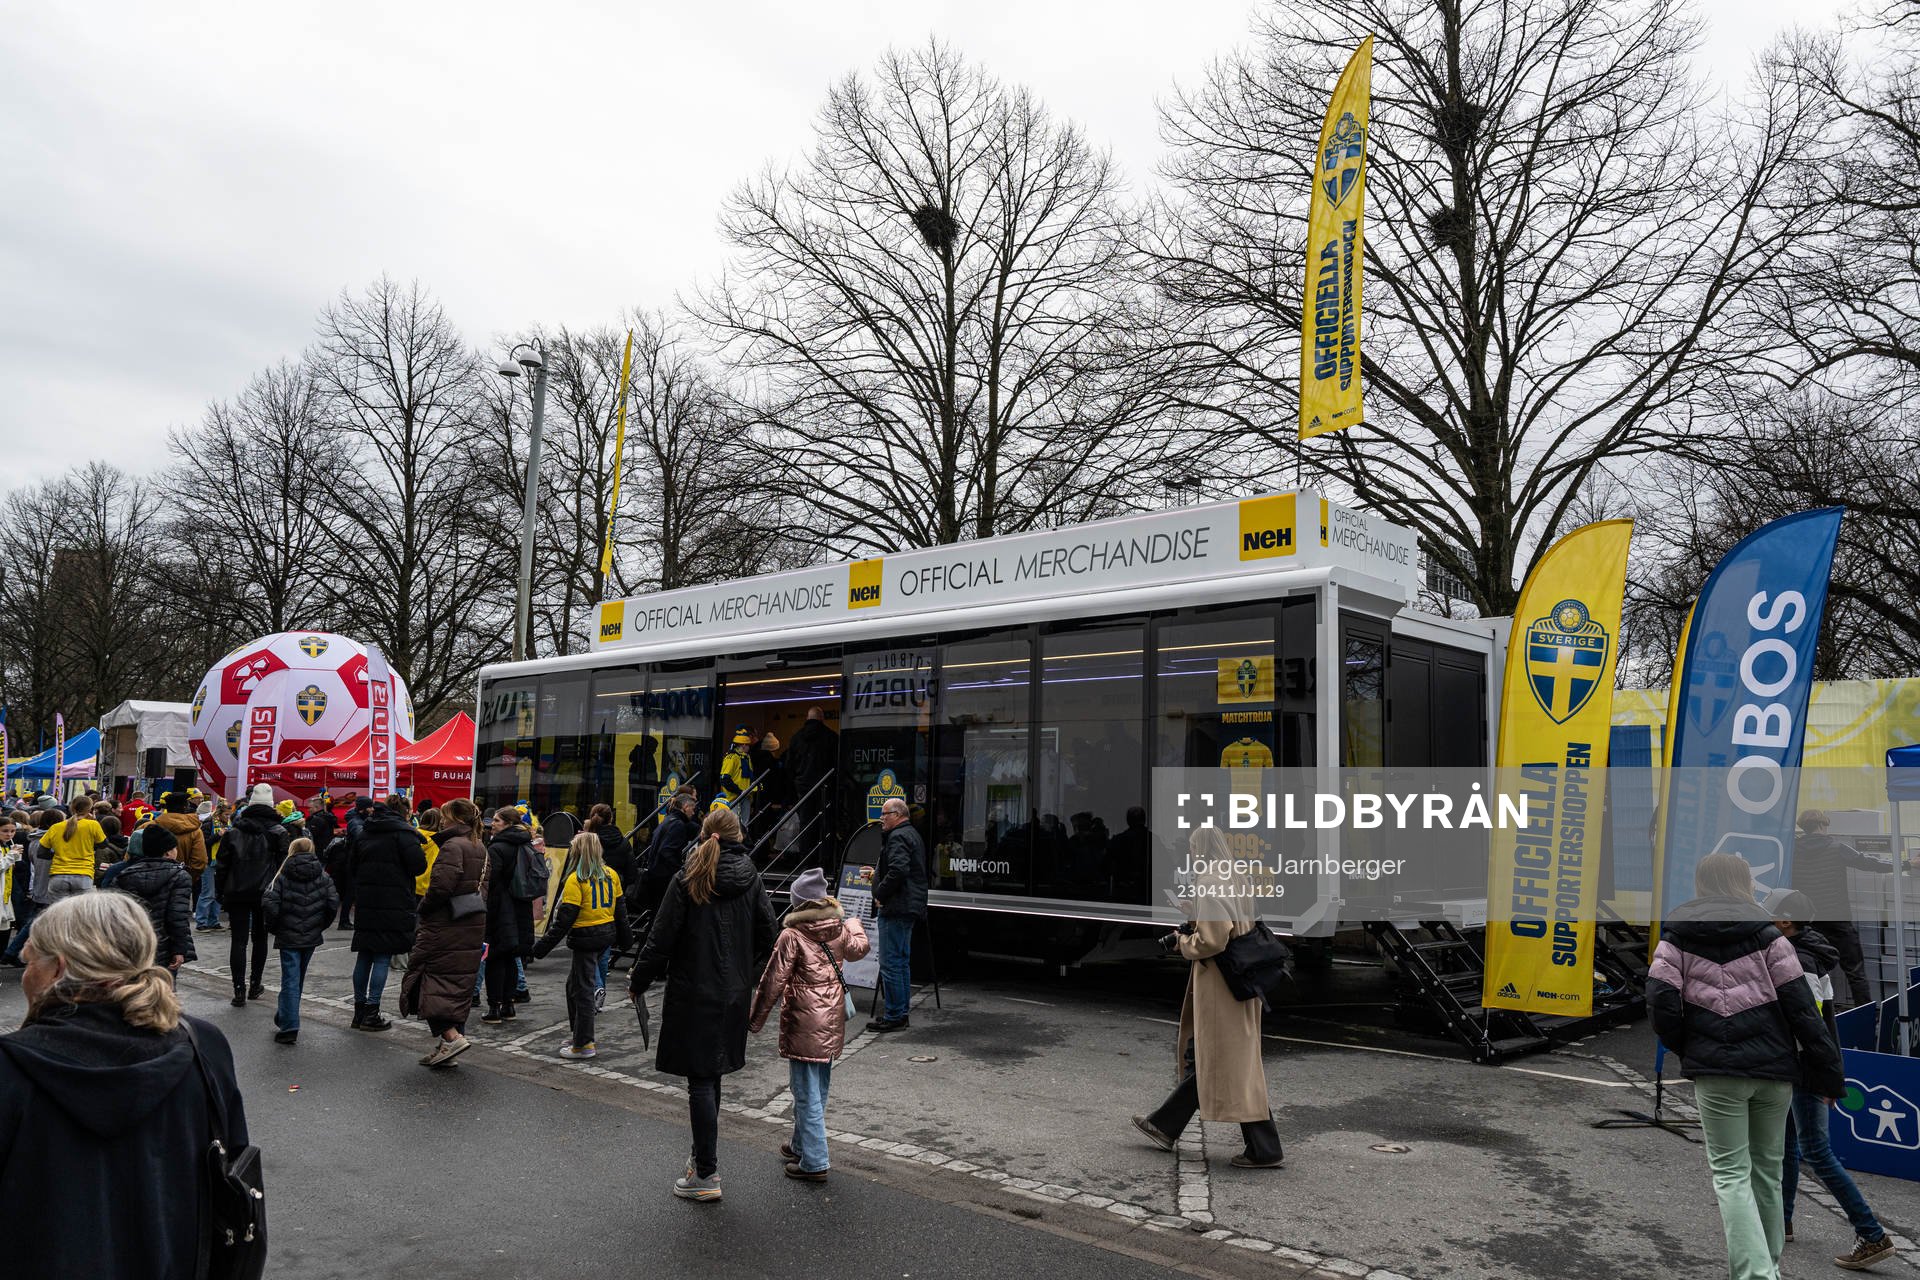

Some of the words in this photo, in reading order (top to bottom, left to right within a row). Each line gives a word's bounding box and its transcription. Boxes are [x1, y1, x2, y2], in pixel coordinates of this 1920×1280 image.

[1314, 239, 1339, 380] OFFICIELLA
[1340, 218, 1358, 392] SUPPORTERSHOPPEN
[1334, 509, 1369, 531] OFFICIAL
[899, 558, 1003, 596] OFFICIAL
[1014, 526, 1211, 581] MERCHANDISE
[1332, 527, 1409, 567] MERCHANDISE
[634, 602, 702, 633] OFFICIAL
[709, 583, 834, 623] MERCHANDISE
[1539, 634, 1596, 647] SVERIGE
[1222, 710, 1272, 724] MATCHTRÖJA
[1726, 589, 1807, 815] OBOS
[434, 771, 471, 780] BAUHA
[1510, 761, 1559, 939] OFFICIELLA
[1552, 741, 1592, 967] SUPPORTERSHOPPEN
[590, 877, 613, 909] 10
